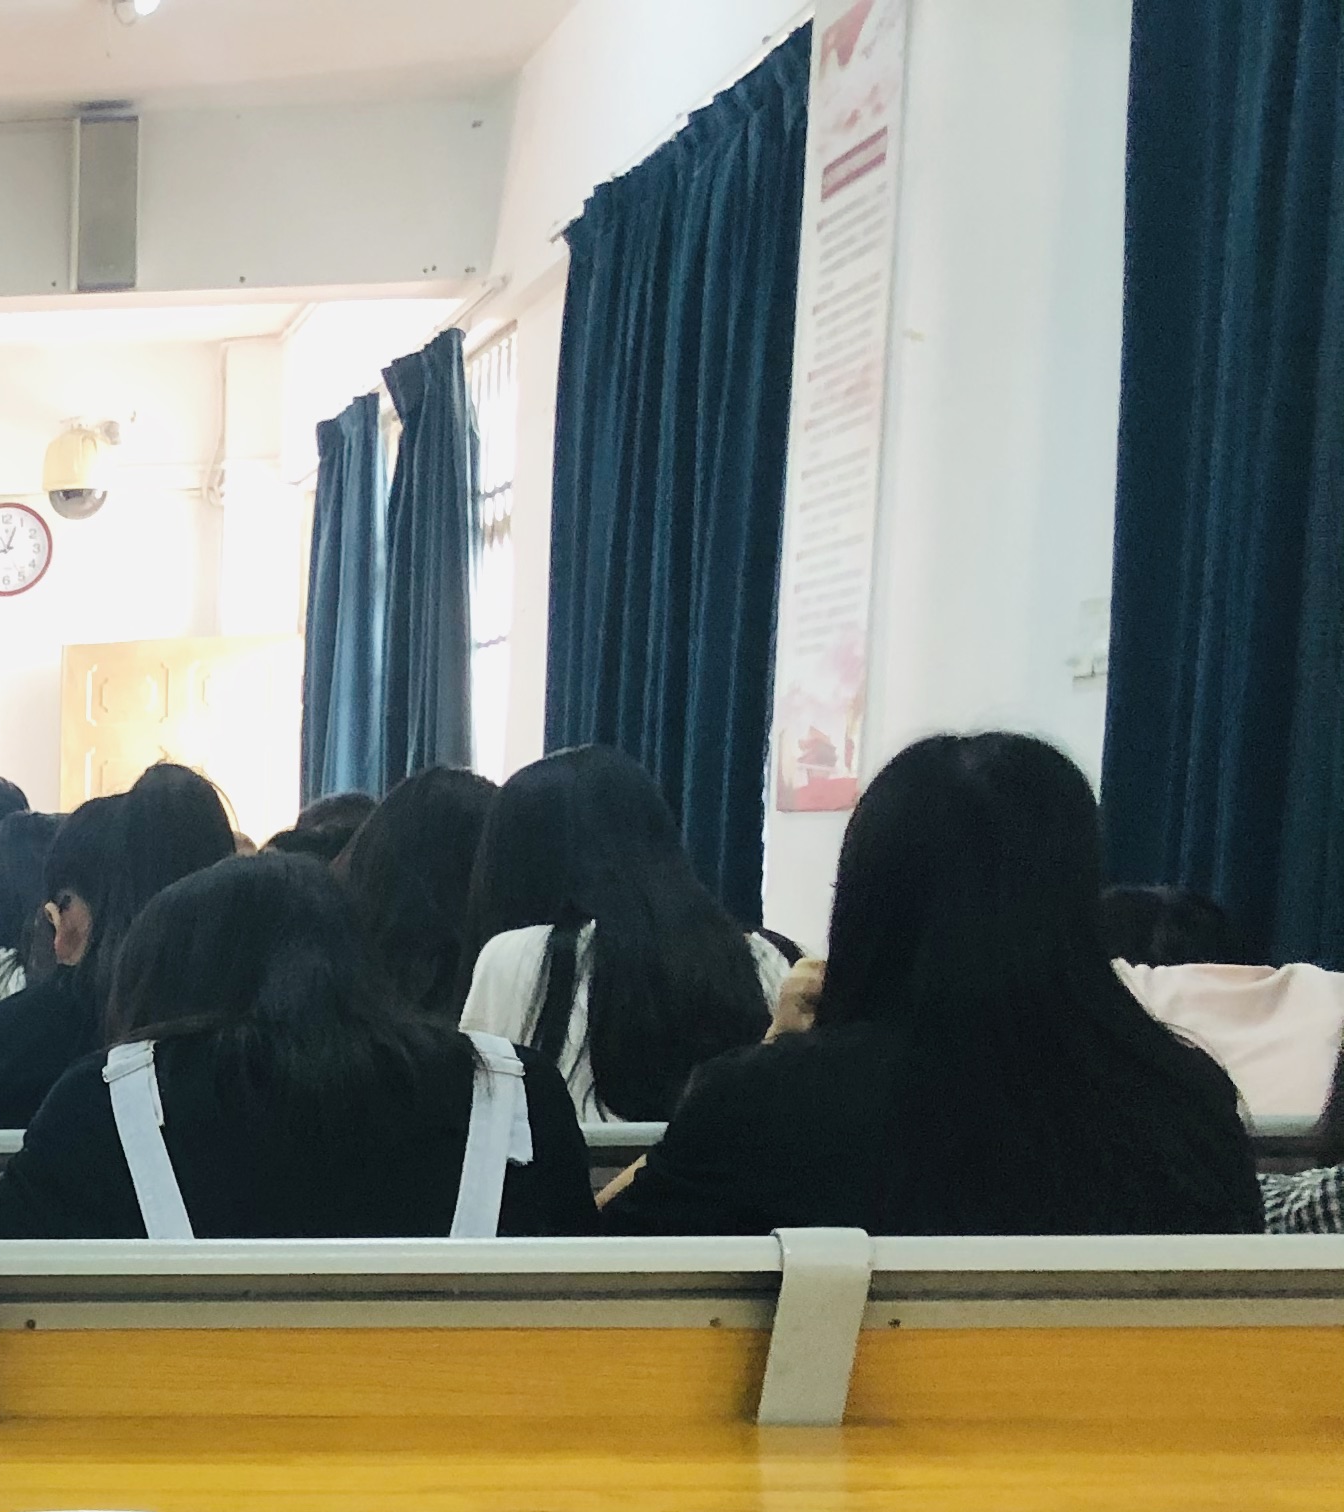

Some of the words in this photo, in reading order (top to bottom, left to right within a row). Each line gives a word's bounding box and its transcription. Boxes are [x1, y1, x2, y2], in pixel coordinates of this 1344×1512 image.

[1, 513, 13, 525] 12
[28, 528, 37, 540] 2
[32, 543, 41, 554] 3
[28, 558, 36, 569] 4
[2, 575, 11, 586] 6
[17, 571, 26, 582] 5
